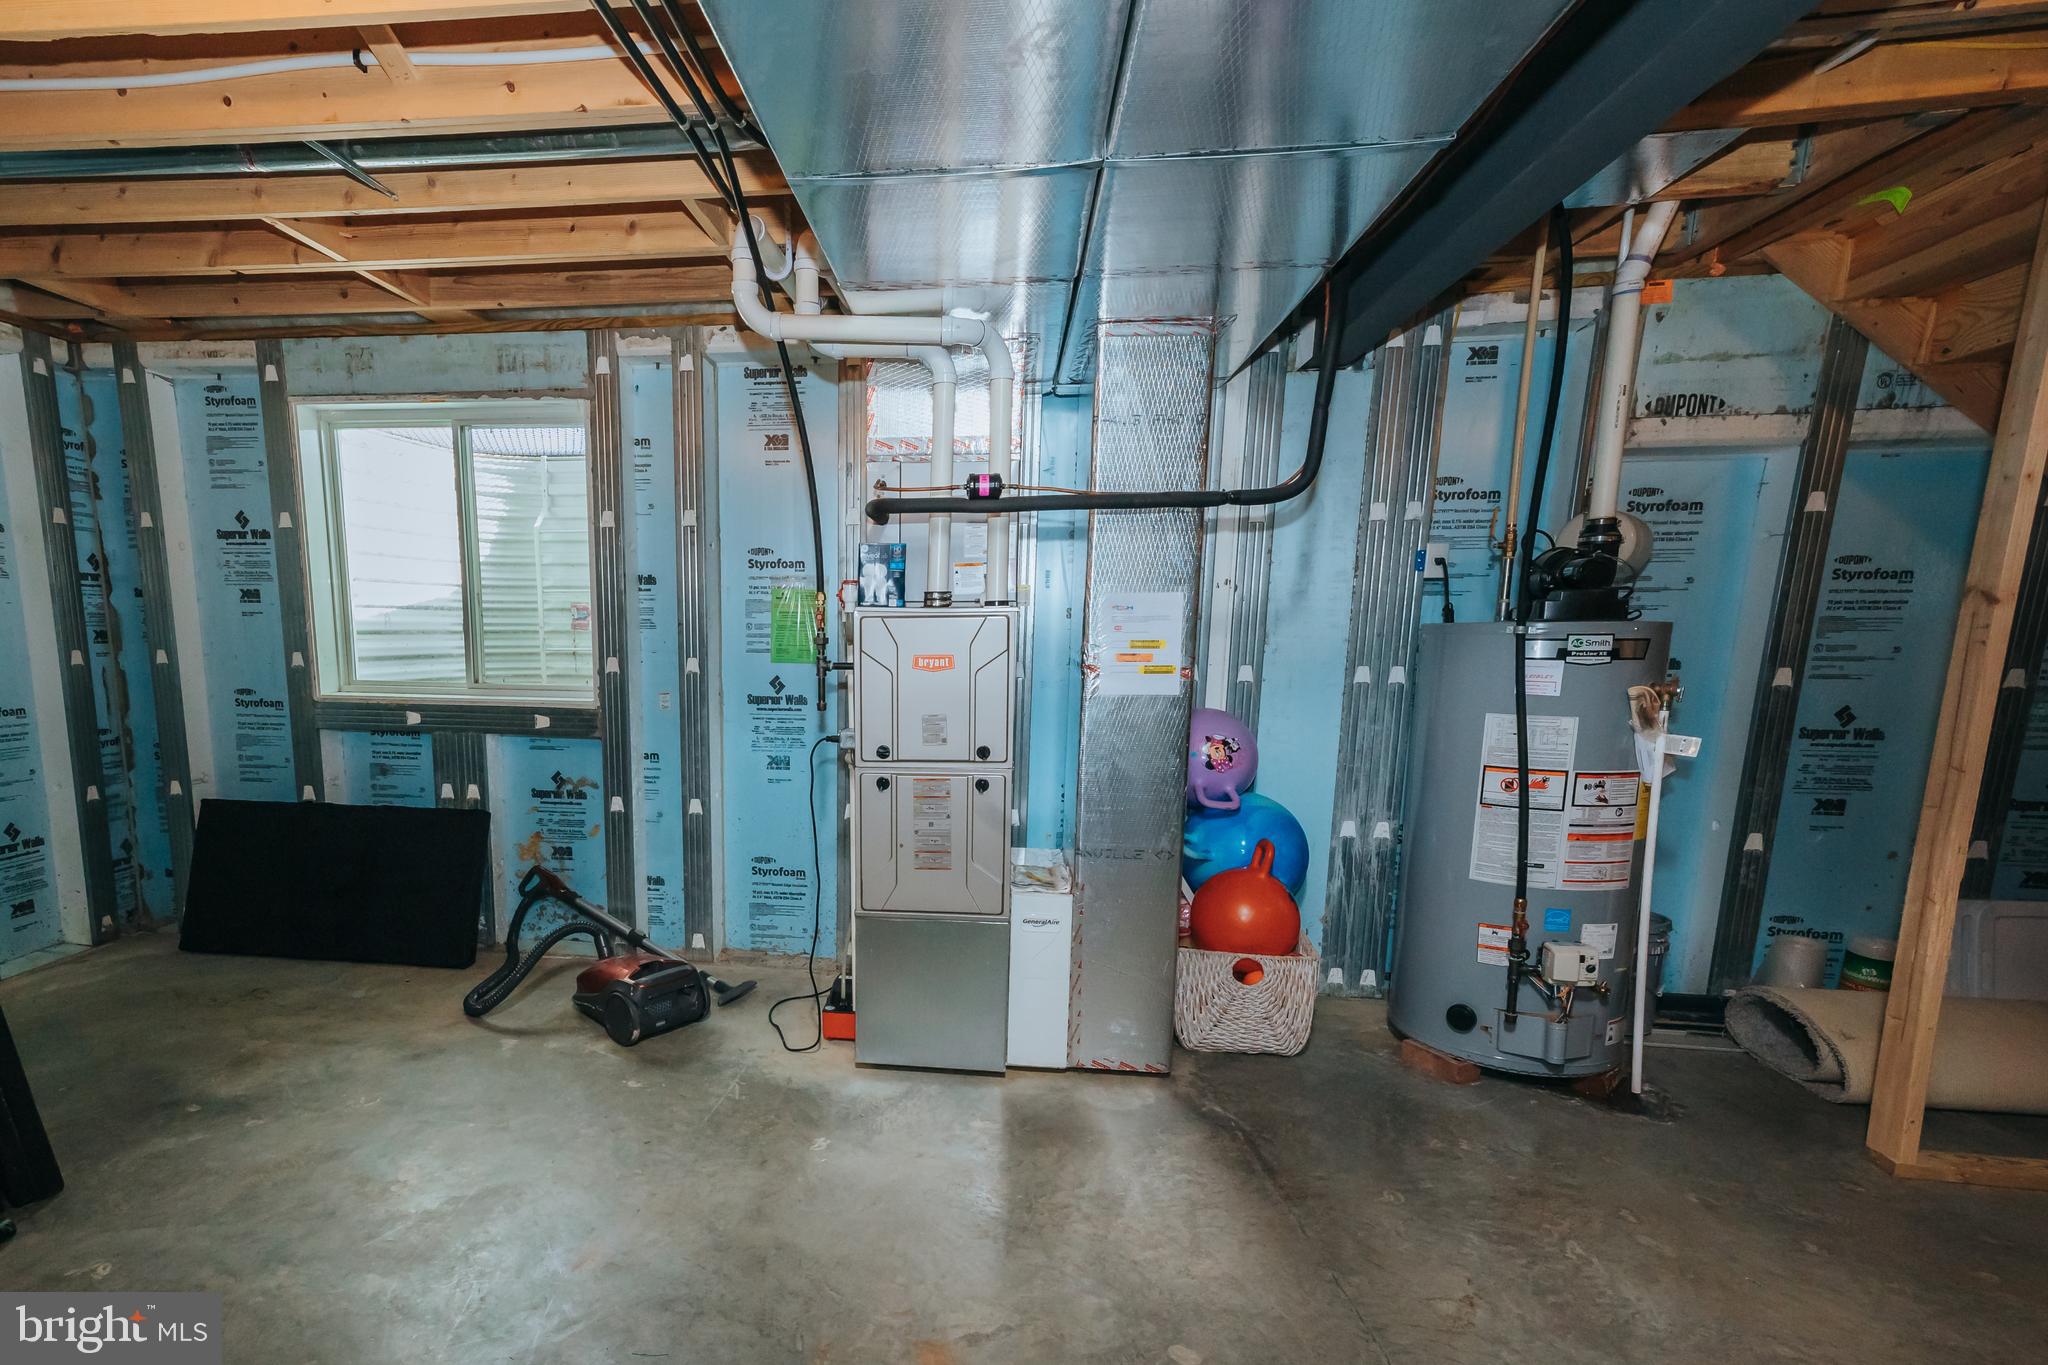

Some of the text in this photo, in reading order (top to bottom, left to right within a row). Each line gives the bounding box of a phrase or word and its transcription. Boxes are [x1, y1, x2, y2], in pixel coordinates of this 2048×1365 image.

[743, 366, 781, 380] Superior
[204, 395, 257, 408] Styrofoam
[1653, 393, 1718, 417] DUPONT
[1631, 487, 1660, 498] DUPONT
[1626, 499, 1704, 515] Styrofoam
[216, 529, 272, 541] Superior Walls
[750, 547, 771, 556] DUPONT
[747, 558, 806, 571] Styrofoam
[1838, 555, 1868, 565] DUPONT
[1831, 567, 1915, 583] Styrofoam
[1585, 638, 1612, 648] Smith
[918, 657, 950, 668] bryant
[234, 698, 284, 709] Styrofoam
[747, 693, 808, 706] Superior Walls
[1798, 726, 1886, 741] Superior Walls
[751, 866, 807, 878] Styrofoam
[1022, 918, 1060, 927] GeneralAire
[1767, 926, 1845, 941] Styrofoam
